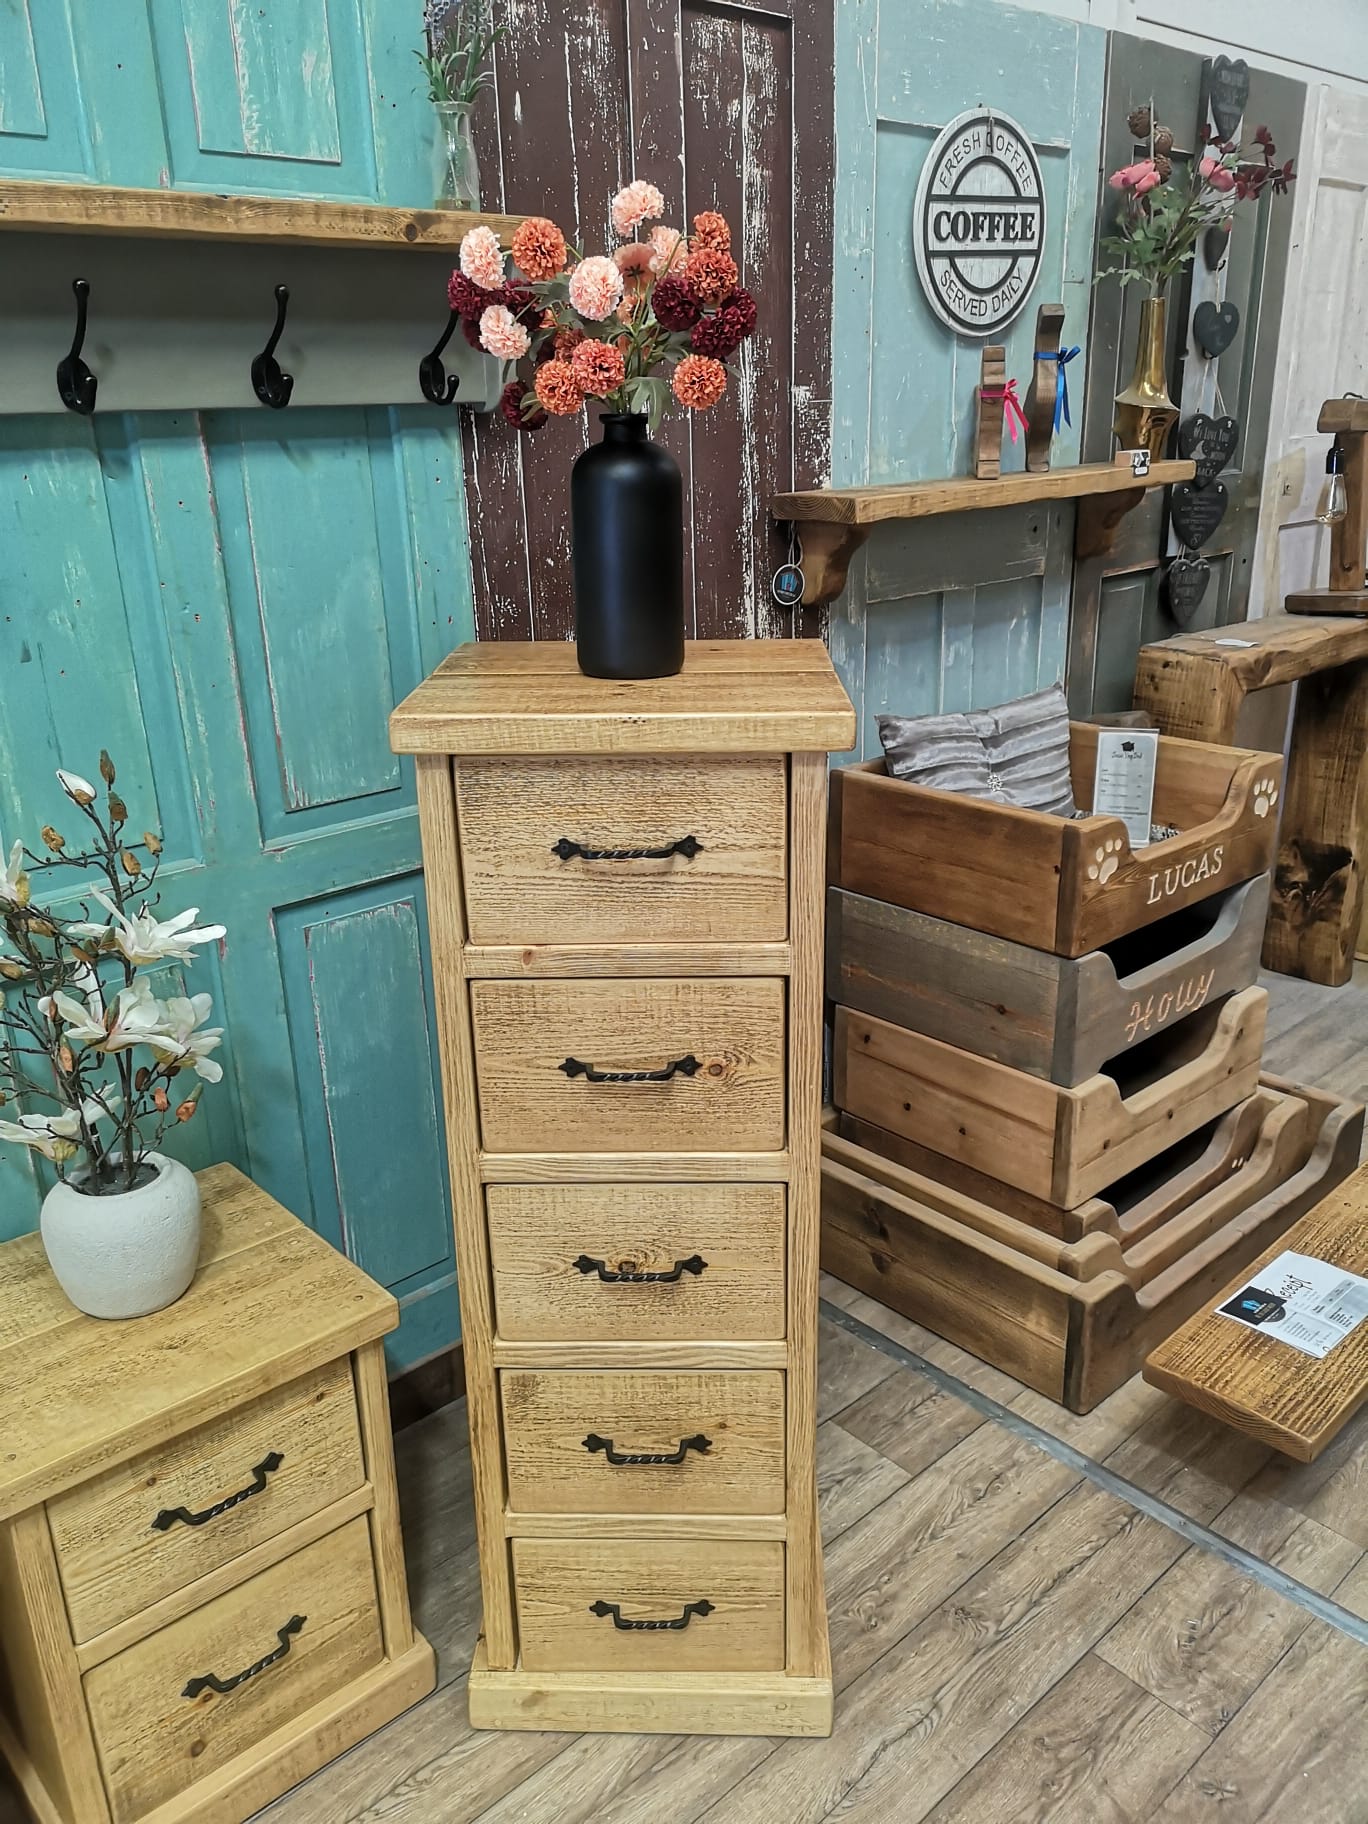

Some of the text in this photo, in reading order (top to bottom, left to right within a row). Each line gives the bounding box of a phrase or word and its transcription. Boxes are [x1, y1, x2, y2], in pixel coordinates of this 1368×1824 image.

[940, 131, 1032, 192] FRESH COFFEE
[933, 211, 1036, 243] COFFEE
[940, 266, 1024, 317] SERVED DAILY
[1146, 846, 1225, 905] LUCAS
